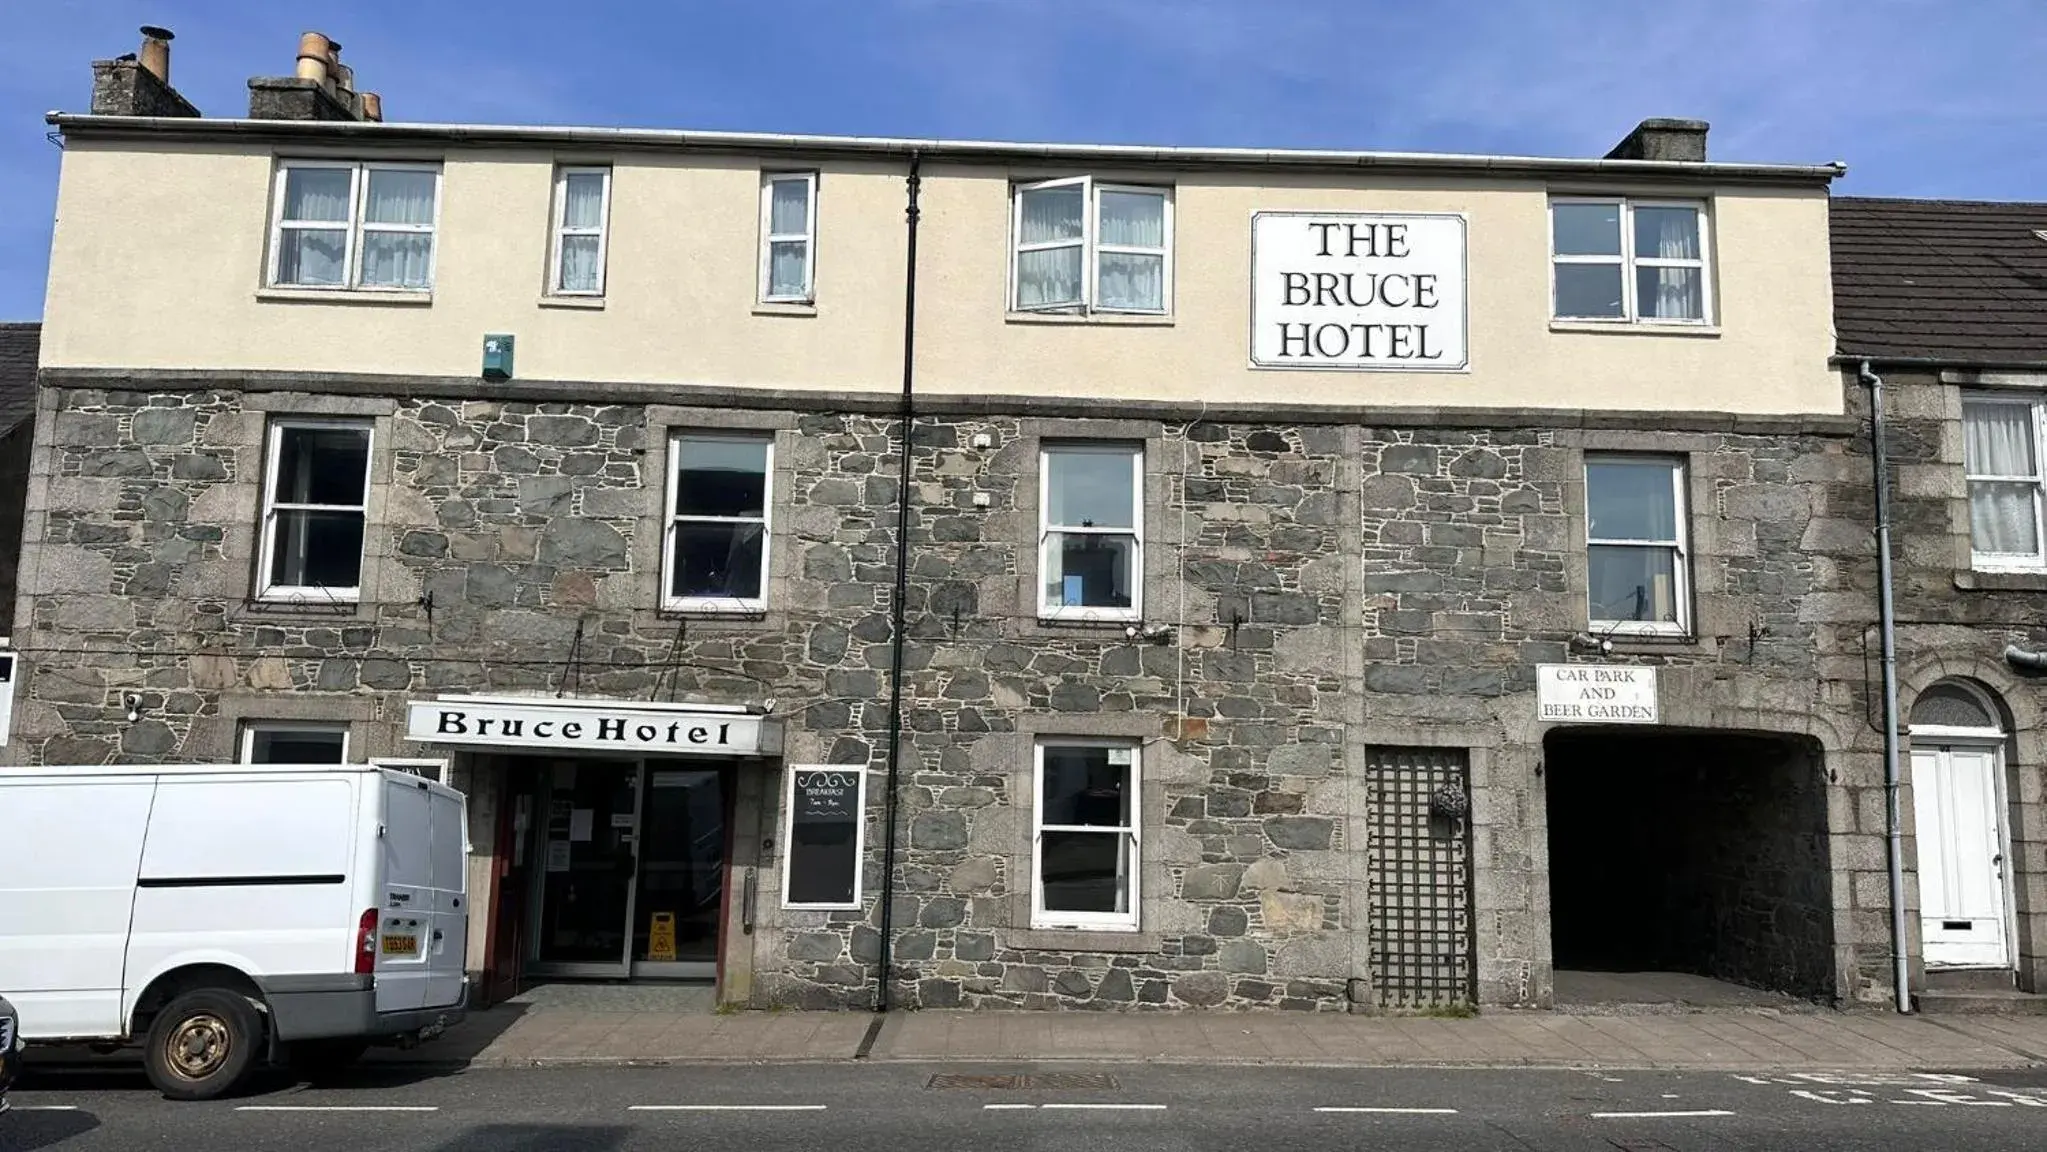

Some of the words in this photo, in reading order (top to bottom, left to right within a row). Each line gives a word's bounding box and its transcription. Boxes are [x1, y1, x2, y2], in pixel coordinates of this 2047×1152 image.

[1308, 222, 1411, 258] THE
[1279, 271, 1440, 309] BRUCE
[1276, 322, 1443, 360] HOTEL
[1556, 668, 1589, 682] CAR
[1594, 669, 1636, 683] PARK
[1544, 703, 1582, 717] BEER
[1587, 704, 1653, 719] GARDEN
[1579, 687, 1616, 700] AND
[436, 710, 583, 740] Bruce
[596, 717, 732, 745] Hotel
